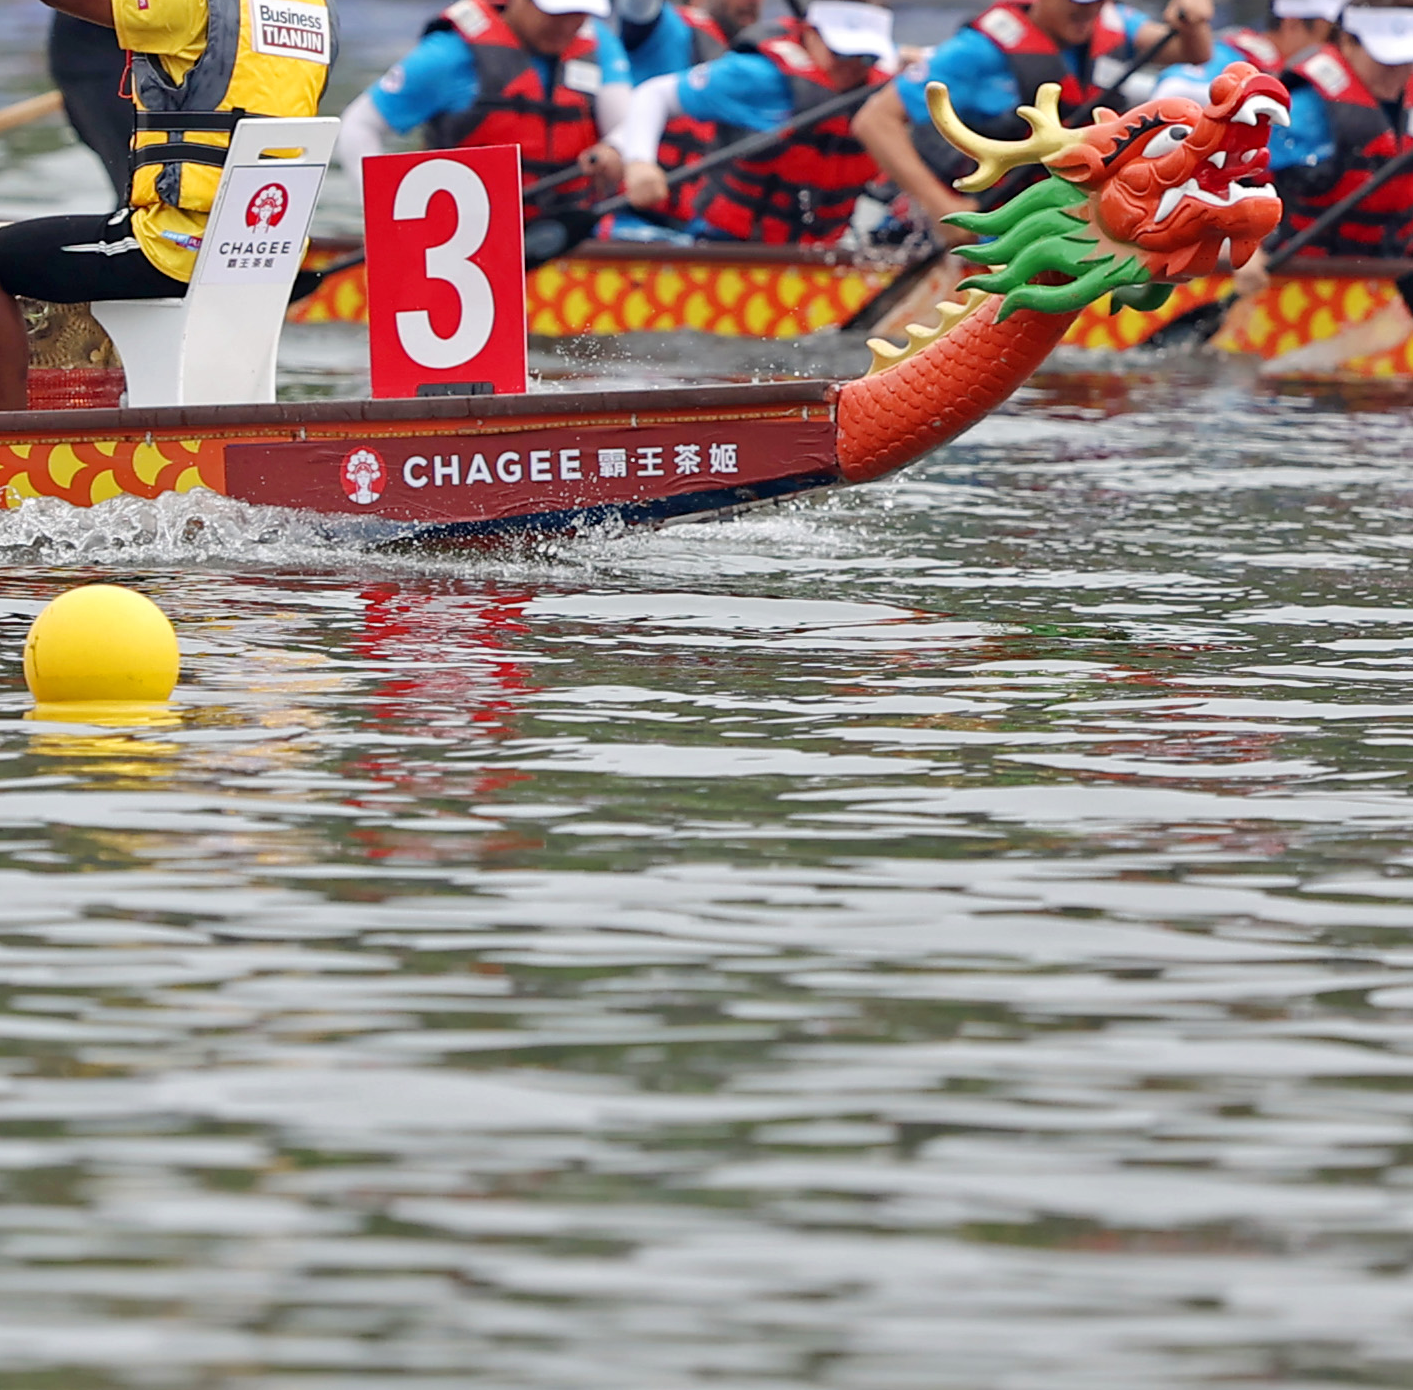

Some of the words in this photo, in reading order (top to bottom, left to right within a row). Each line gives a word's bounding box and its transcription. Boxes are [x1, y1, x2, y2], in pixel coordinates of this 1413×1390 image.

[260, 4, 322, 30] Business
[262, 24, 324, 53] TIANJIN
[219, 241, 292, 256] CHAGEE
[393, 158, 495, 369] 3
[403, 448, 583, 489] CHAGEE
[597, 443, 739, 479] 霸王茶姬
